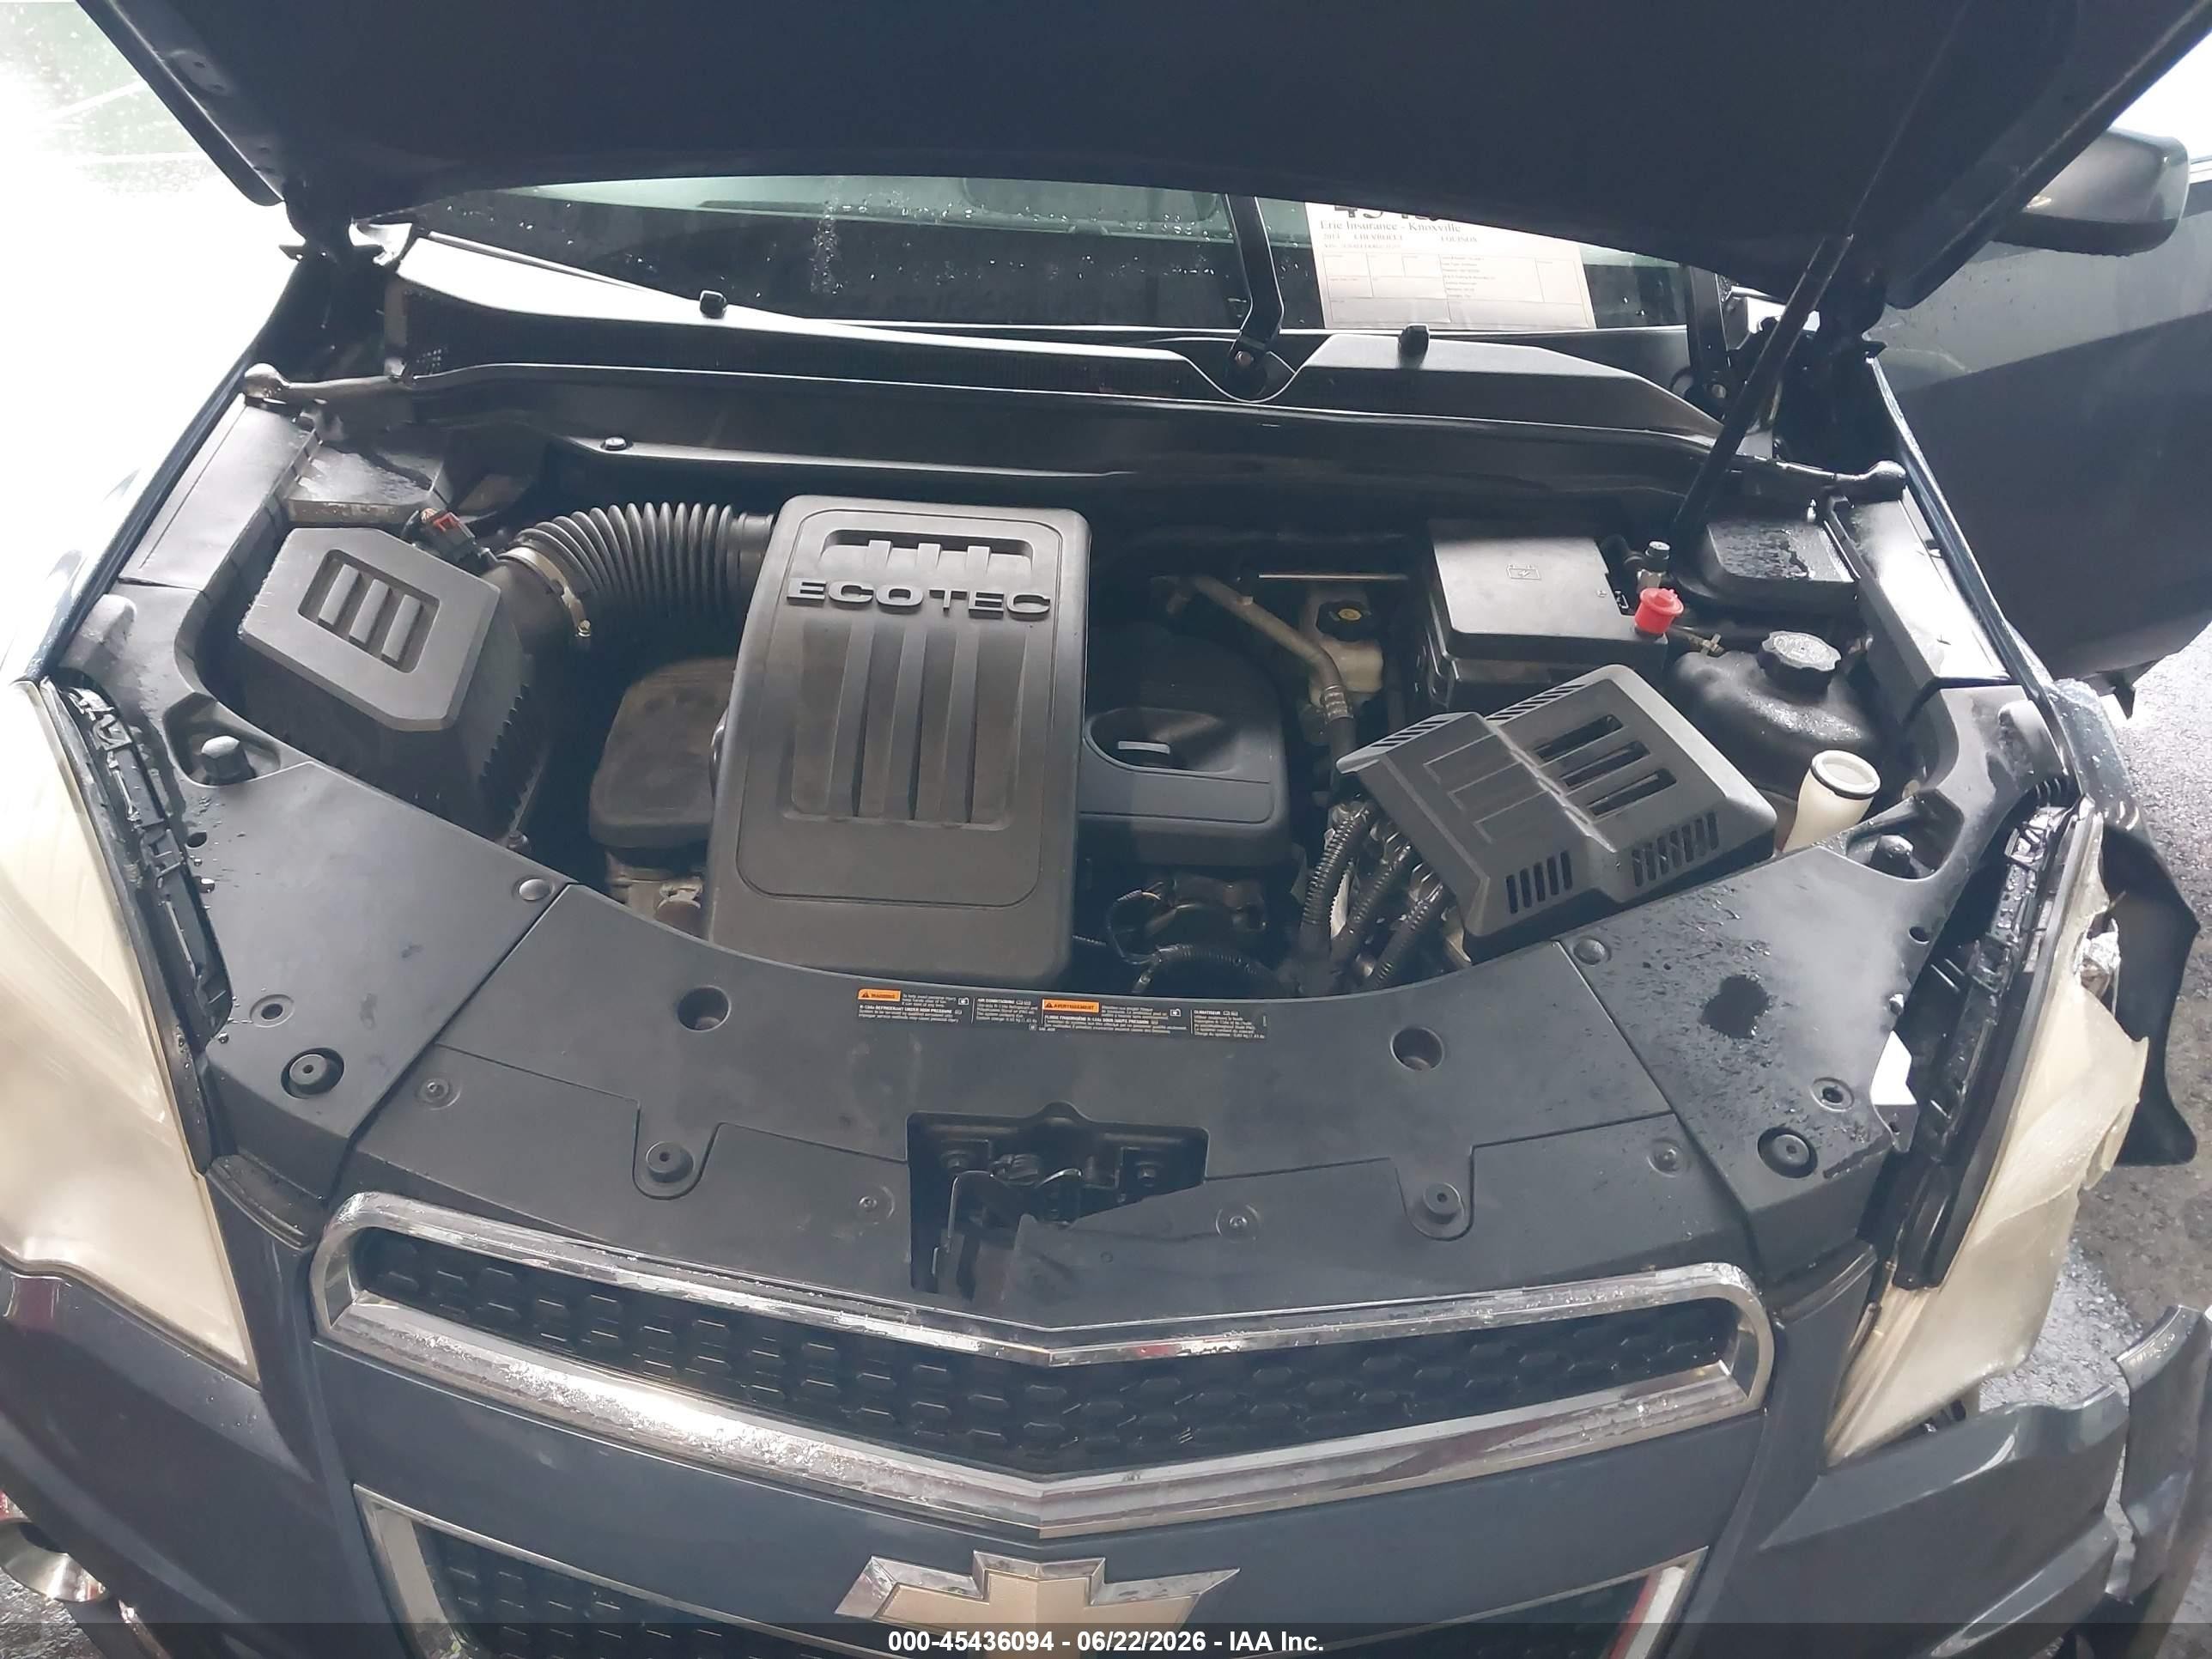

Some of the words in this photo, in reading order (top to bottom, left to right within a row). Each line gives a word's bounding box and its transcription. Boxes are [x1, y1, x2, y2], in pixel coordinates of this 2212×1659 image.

[1346, 221, 1397, 231] Insurance
[1408, 222, 1461, 233] Knoxville
[787, 578, 1051, 618] ECOTEC
